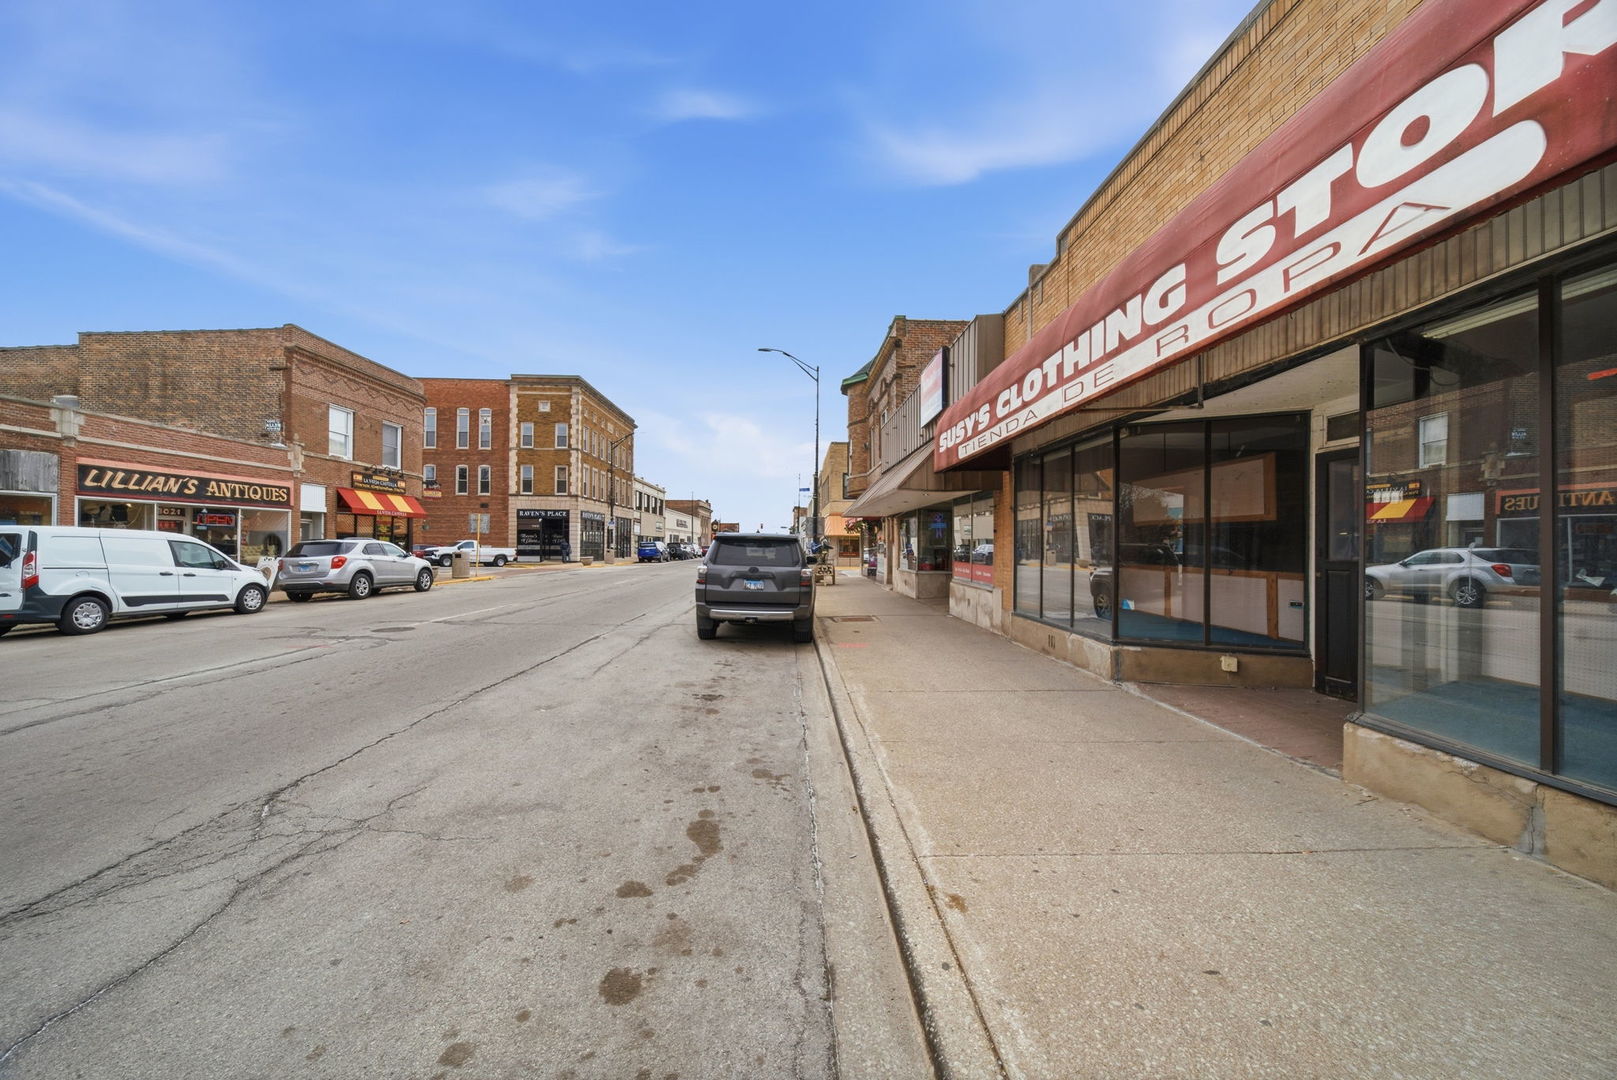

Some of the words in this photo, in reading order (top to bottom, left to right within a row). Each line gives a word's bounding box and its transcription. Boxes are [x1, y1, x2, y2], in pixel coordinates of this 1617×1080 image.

[938, 402, 991, 453] SUSY'S
[996, 262, 1187, 420] CLOTHING
[961, 409, 1039, 455] TIENDA
[1063, 364, 1116, 403] DE
[1156, 201, 1452, 358] ROPA
[84, 468, 200, 495] LILLIAN'S
[206, 480, 288, 502] ANTIQUES
